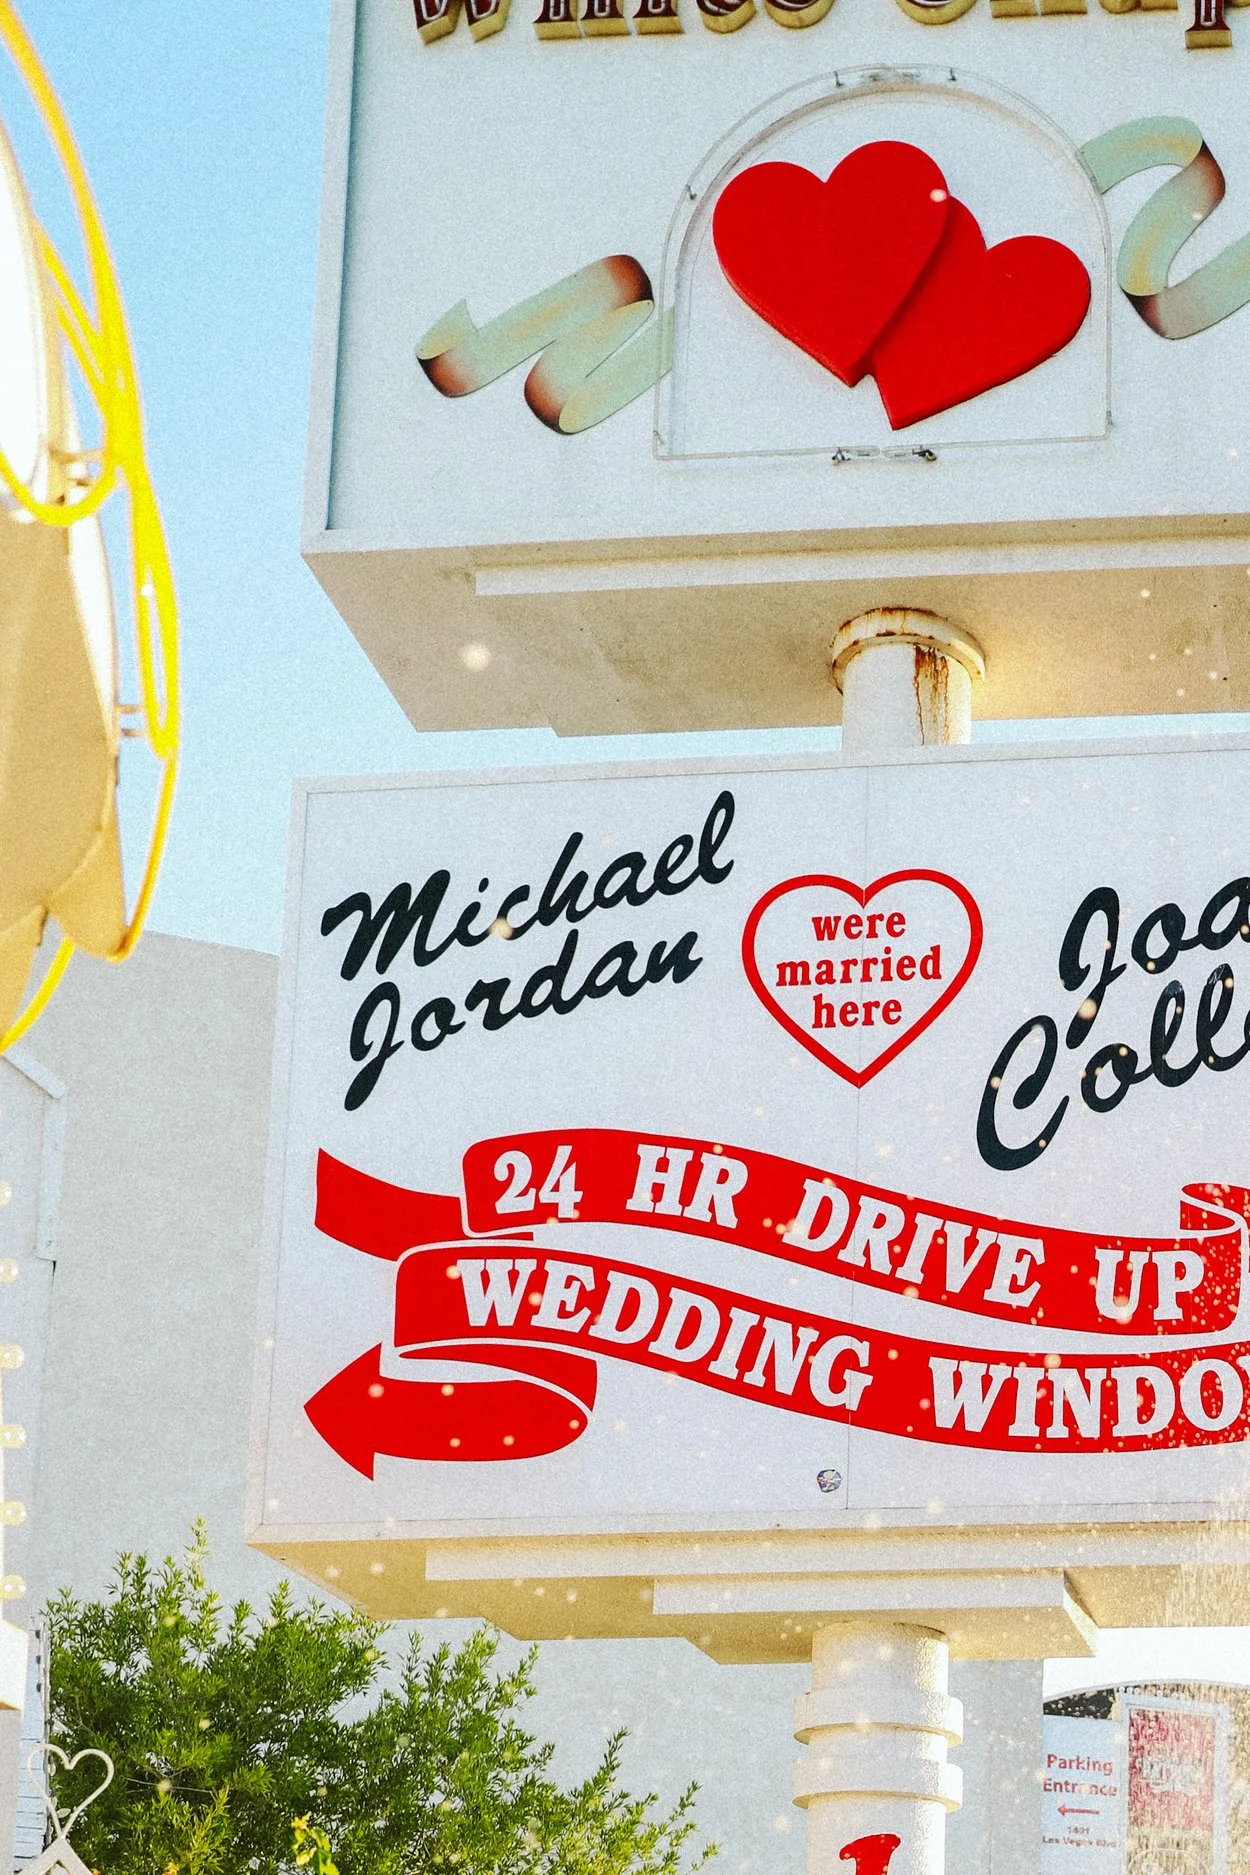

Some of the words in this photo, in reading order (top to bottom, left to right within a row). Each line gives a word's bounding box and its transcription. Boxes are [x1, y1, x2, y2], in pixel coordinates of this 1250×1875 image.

[320, 789, 735, 981] Michael
[811, 912, 906, 941] were
[775, 944, 941, 987] married
[811, 993, 902, 1028] here
[344, 928, 703, 1112] Jordan
[493, 1145, 584, 1219] 24
[626, 1143, 748, 1229] HR
[777, 1178, 1045, 1309] DRIVE
[1094, 1247, 1205, 1323] UP
[455, 1258, 874, 1411] WEDDING
[1046, 1753, 1113, 1776] Parking
